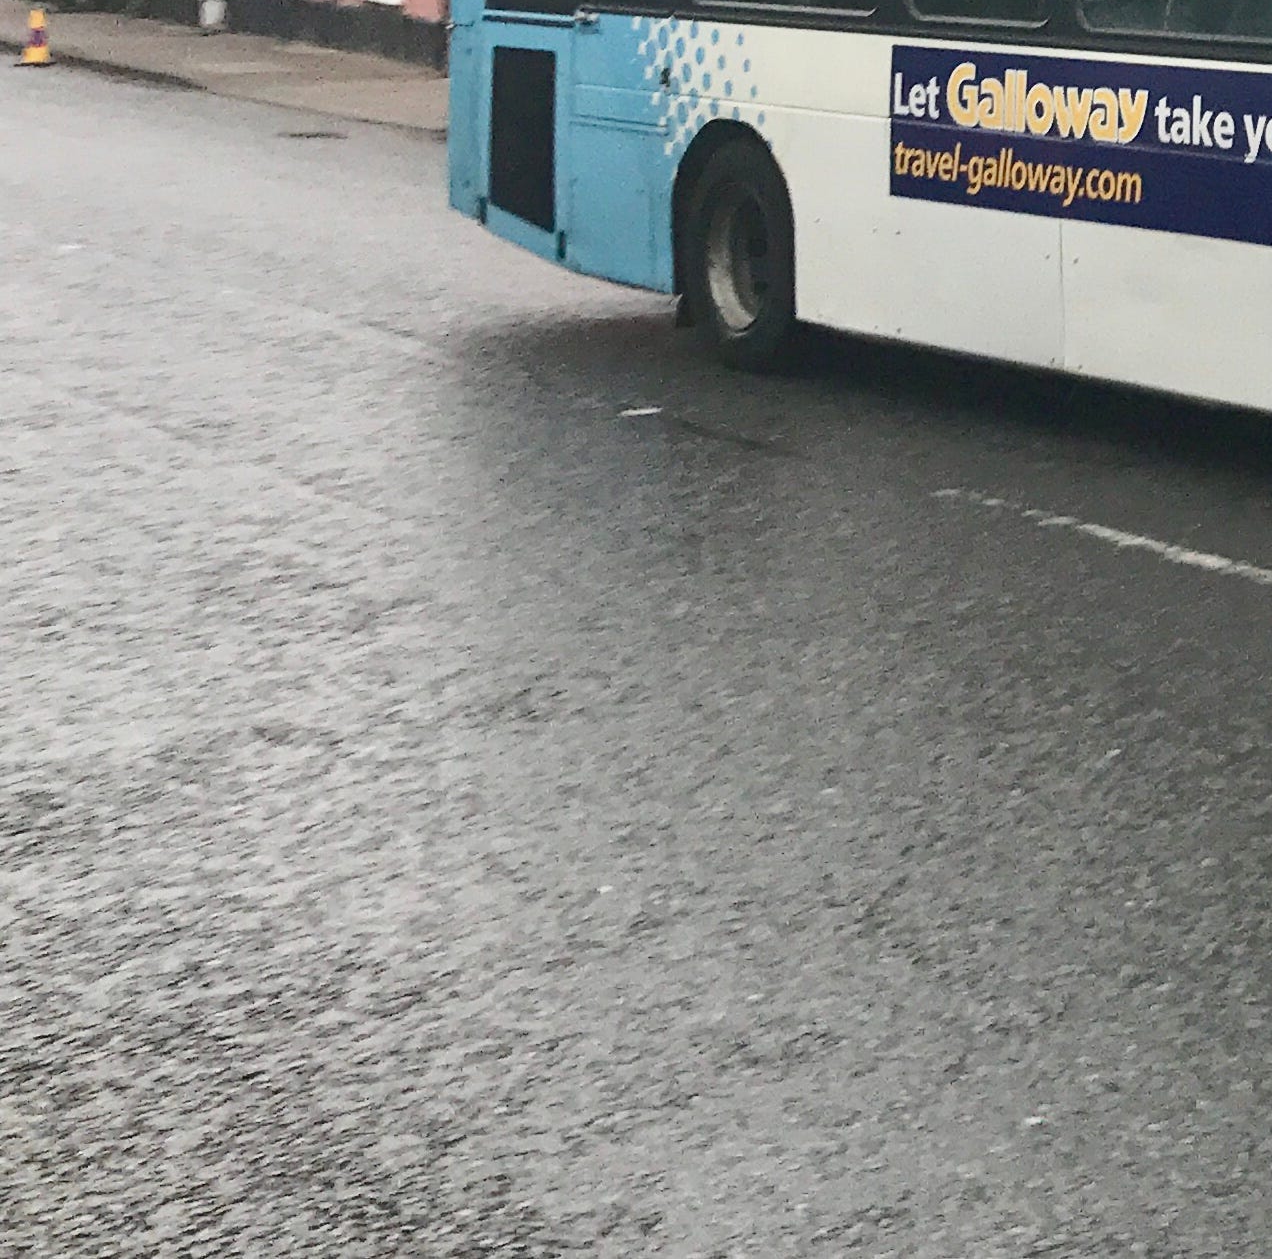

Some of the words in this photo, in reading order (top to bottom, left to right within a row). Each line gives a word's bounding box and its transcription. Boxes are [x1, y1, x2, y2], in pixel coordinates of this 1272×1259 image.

[893, 72, 941, 120] Let
[946, 60, 1150, 145] Galloway
[1154, 94, 1236, 149] take
[894, 141, 1143, 207] travel-galloway.com
